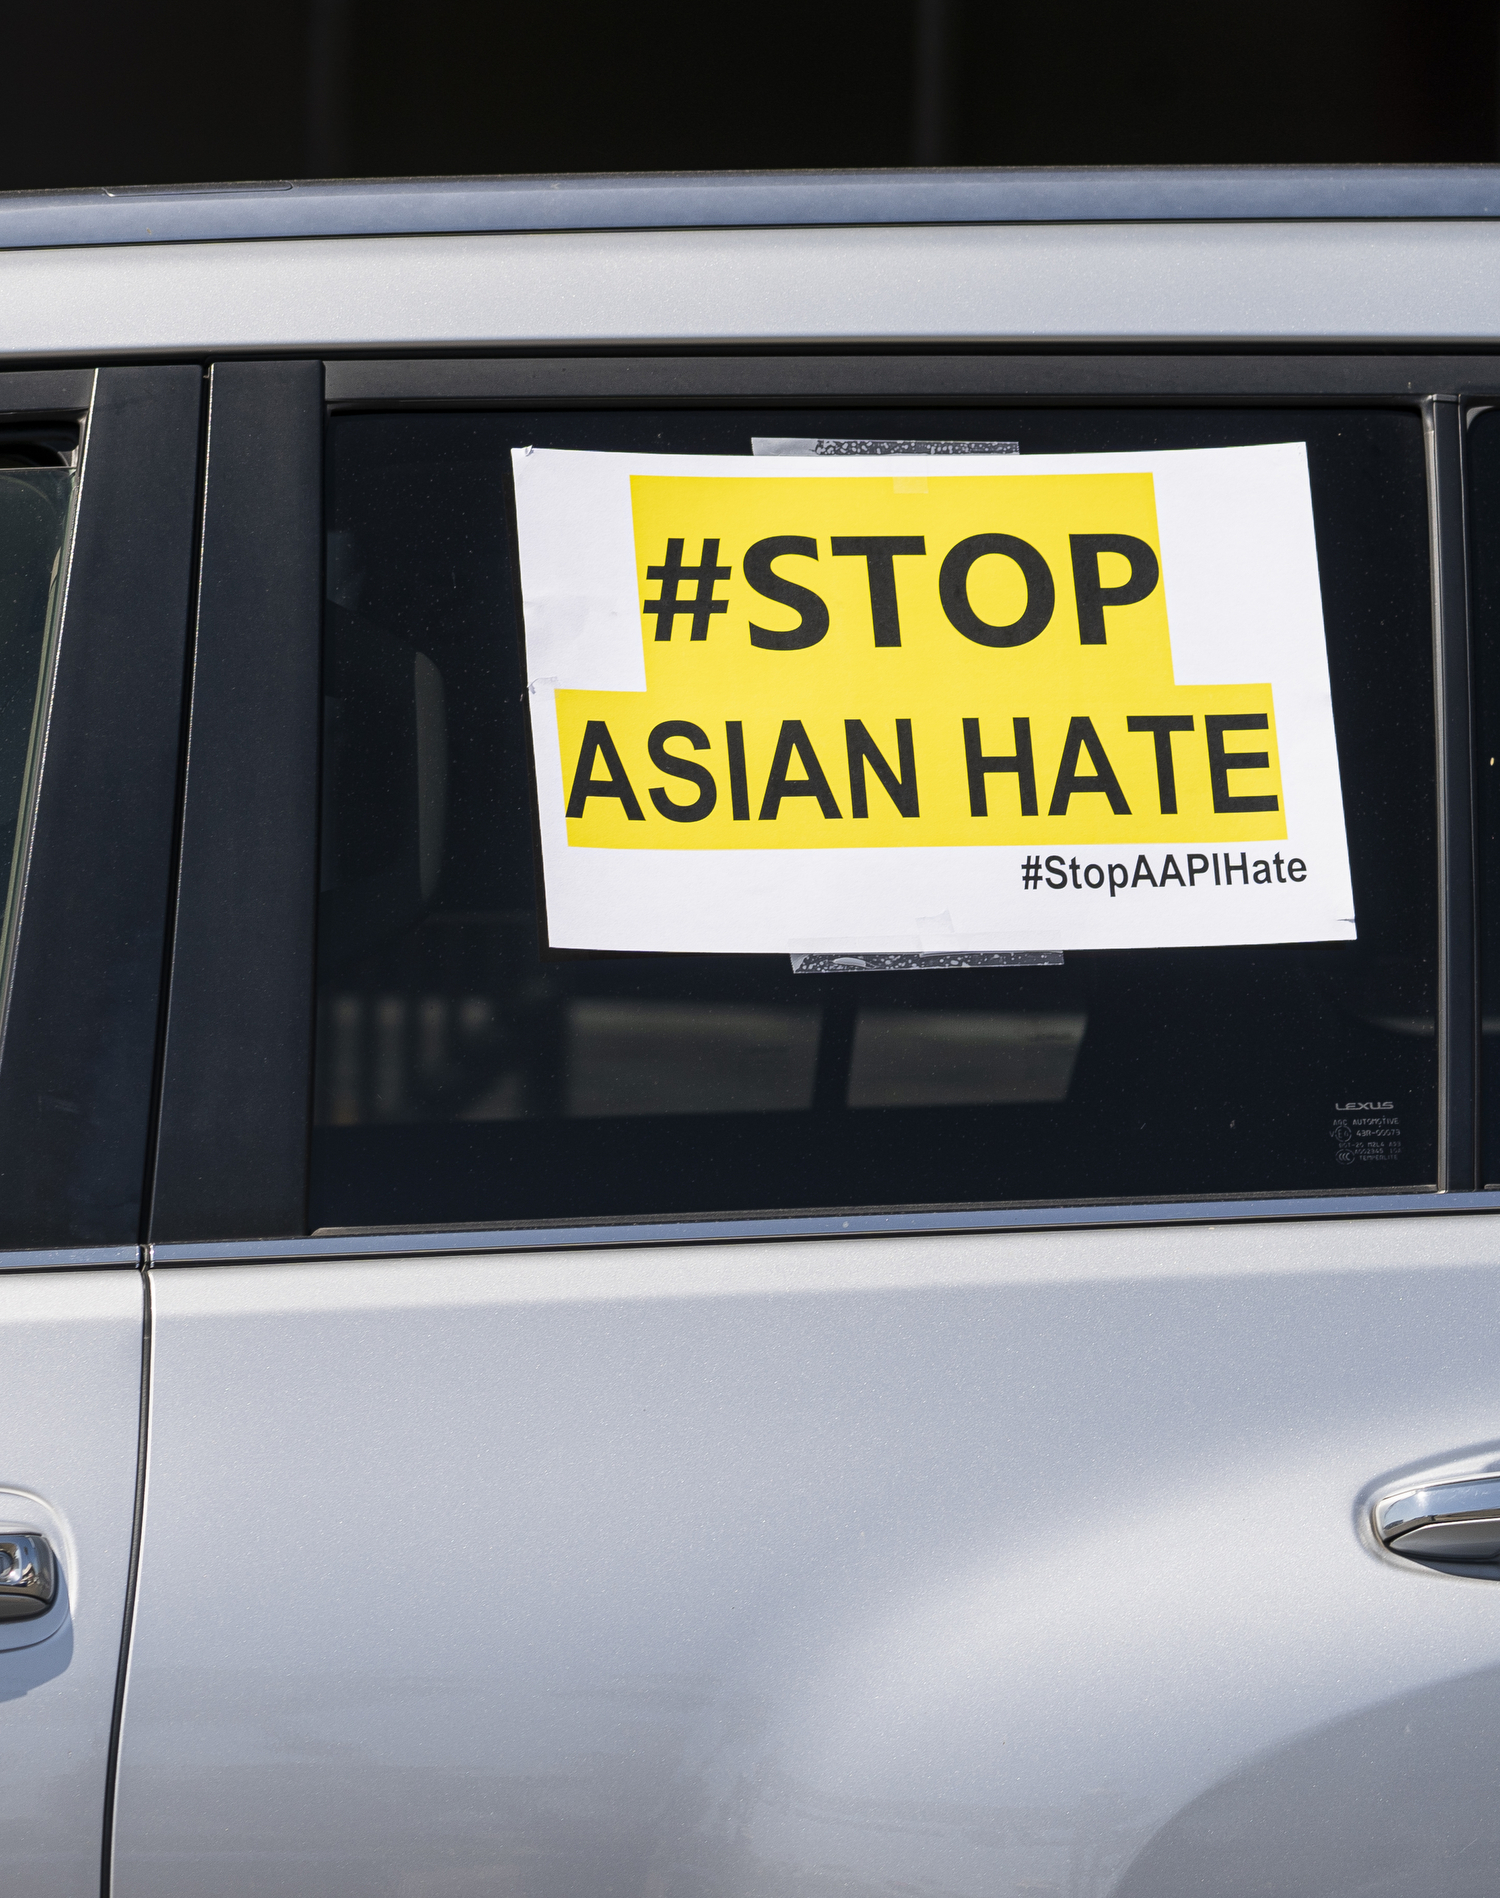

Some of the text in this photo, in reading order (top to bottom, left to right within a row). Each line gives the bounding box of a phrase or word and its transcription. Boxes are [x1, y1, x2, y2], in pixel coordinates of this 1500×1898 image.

[642, 532, 1161, 651] #STOP
[565, 712, 1280, 822] ASIAN HATE
[1021, 851, 1308, 897] #StopAAPIHate
[1335, 1101, 1394, 1111] LEXUS
[1352, 1117, 1400, 1126] AUTOMOTIVE
